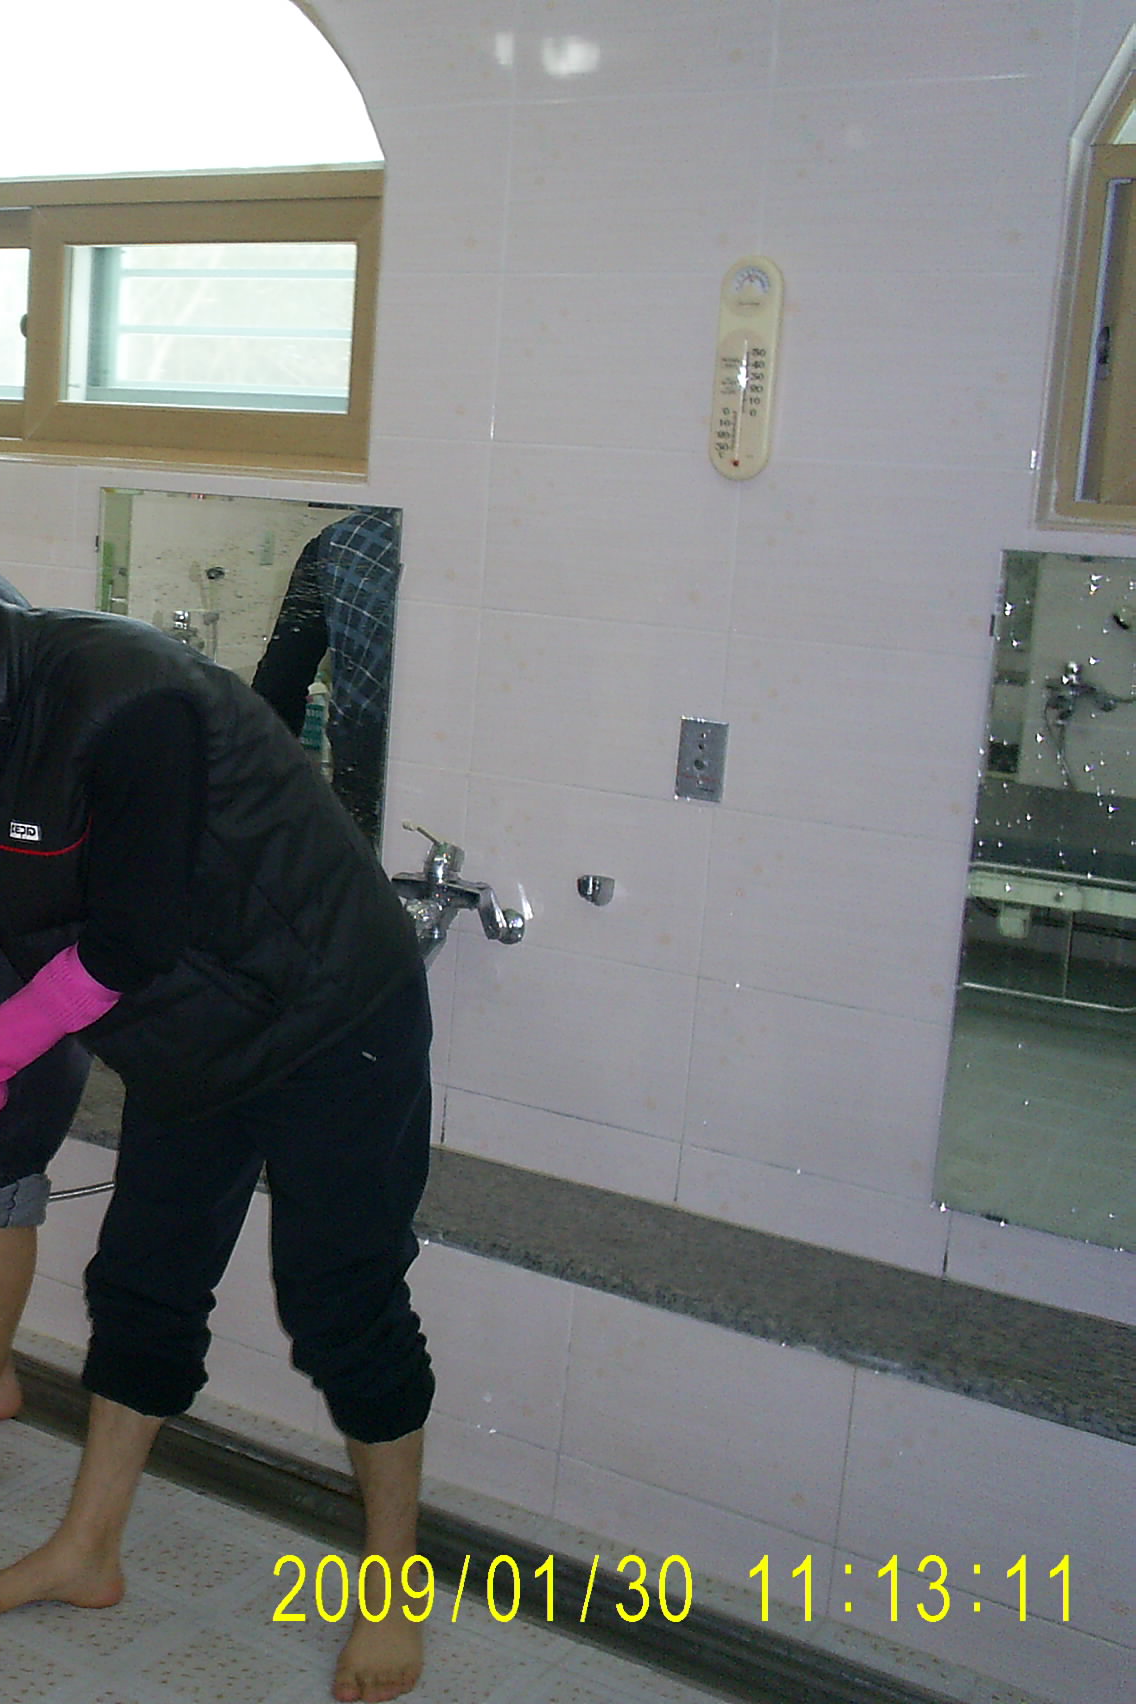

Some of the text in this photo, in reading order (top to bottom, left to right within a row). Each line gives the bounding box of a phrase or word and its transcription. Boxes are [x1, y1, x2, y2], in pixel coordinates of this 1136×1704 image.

[749, 396, 761, 405] 10
[722, 407, 730, 416] 0
[749, 408, 757, 417] 0
